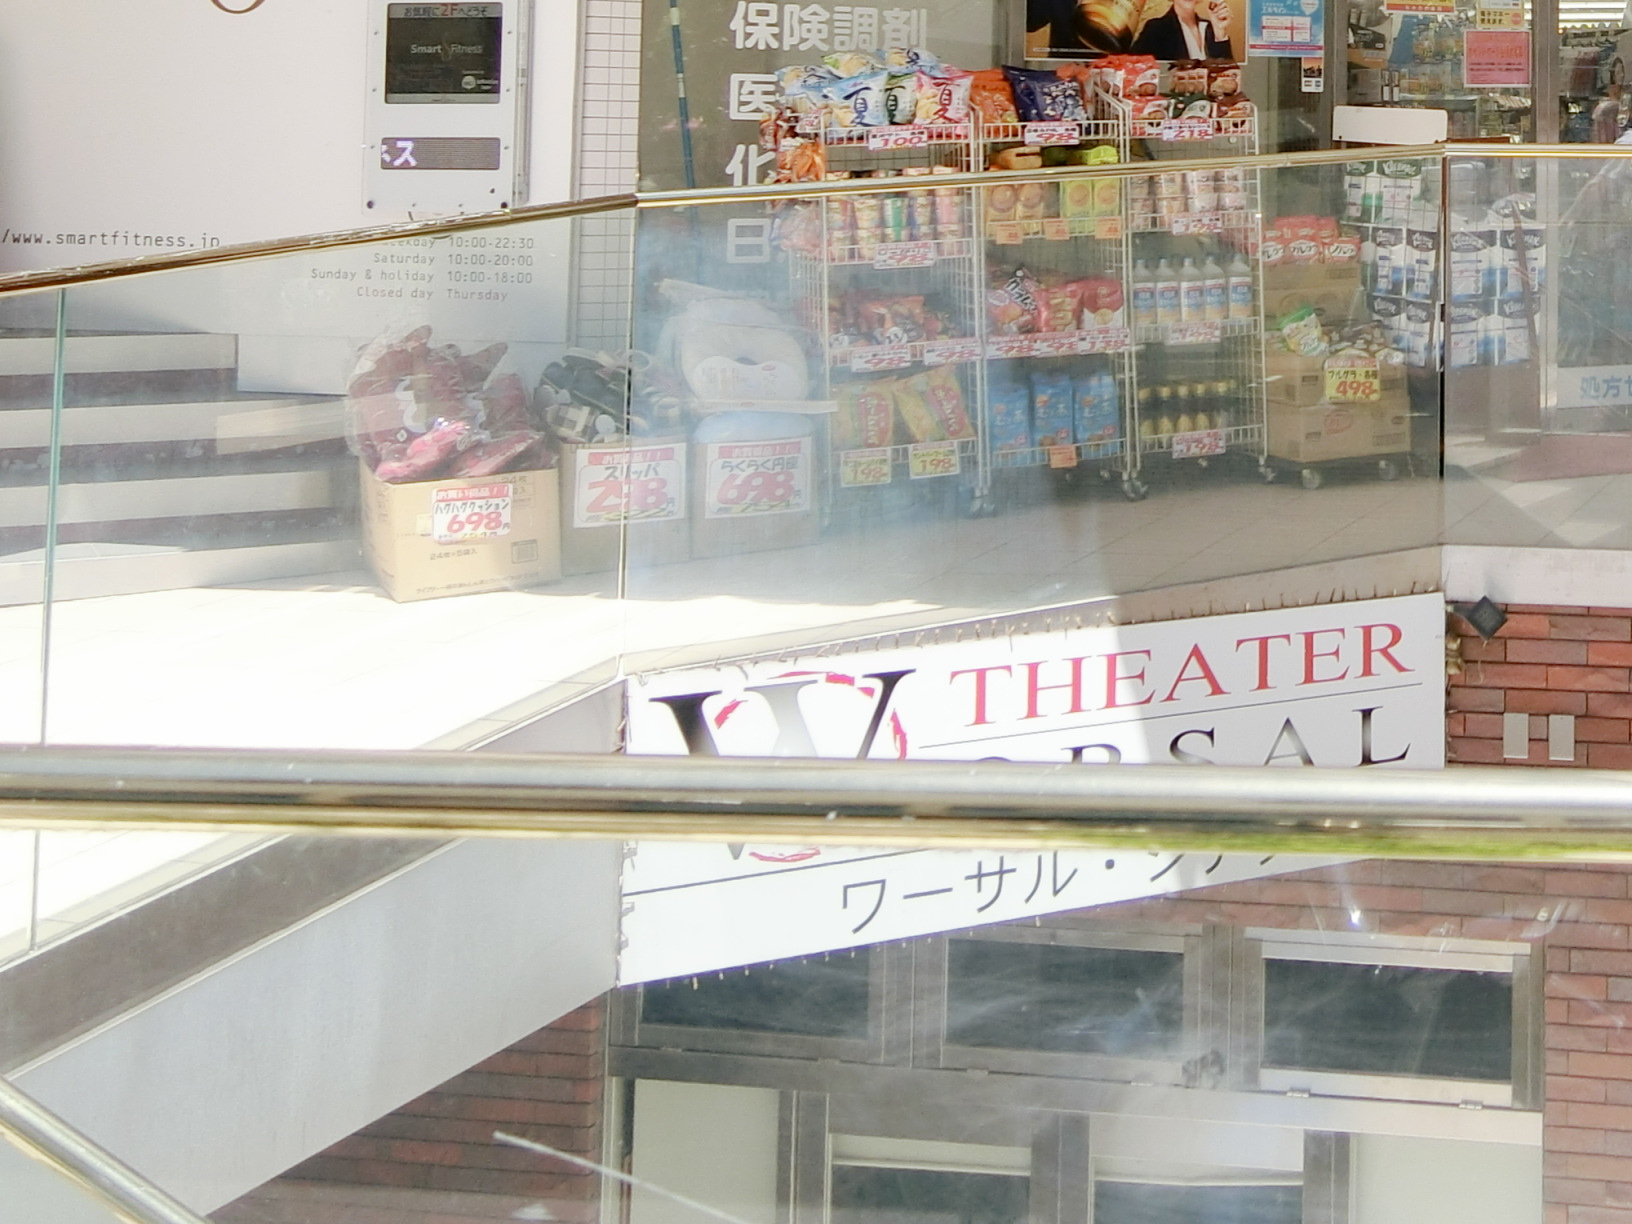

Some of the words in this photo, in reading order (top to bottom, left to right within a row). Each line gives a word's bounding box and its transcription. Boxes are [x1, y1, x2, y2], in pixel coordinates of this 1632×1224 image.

[729, 1, 928, 51] 保険調剤
[411, 45, 442, 54] Smart
[450, 236, 535, 250] 10:00-22:30
[374, 253, 435, 266] Saturday
[448, 253, 534, 267] 10:00-20:00
[311, 269, 356, 282] Sunday
[380, 270, 434, 284] holiday
[448, 270, 533, 284] 10:00-18:00
[357, 287, 403, 299] Closed
[411, 287, 434, 301] day
[447, 288, 508, 302] Thursday
[950, 623, 1415, 727] THEATER
